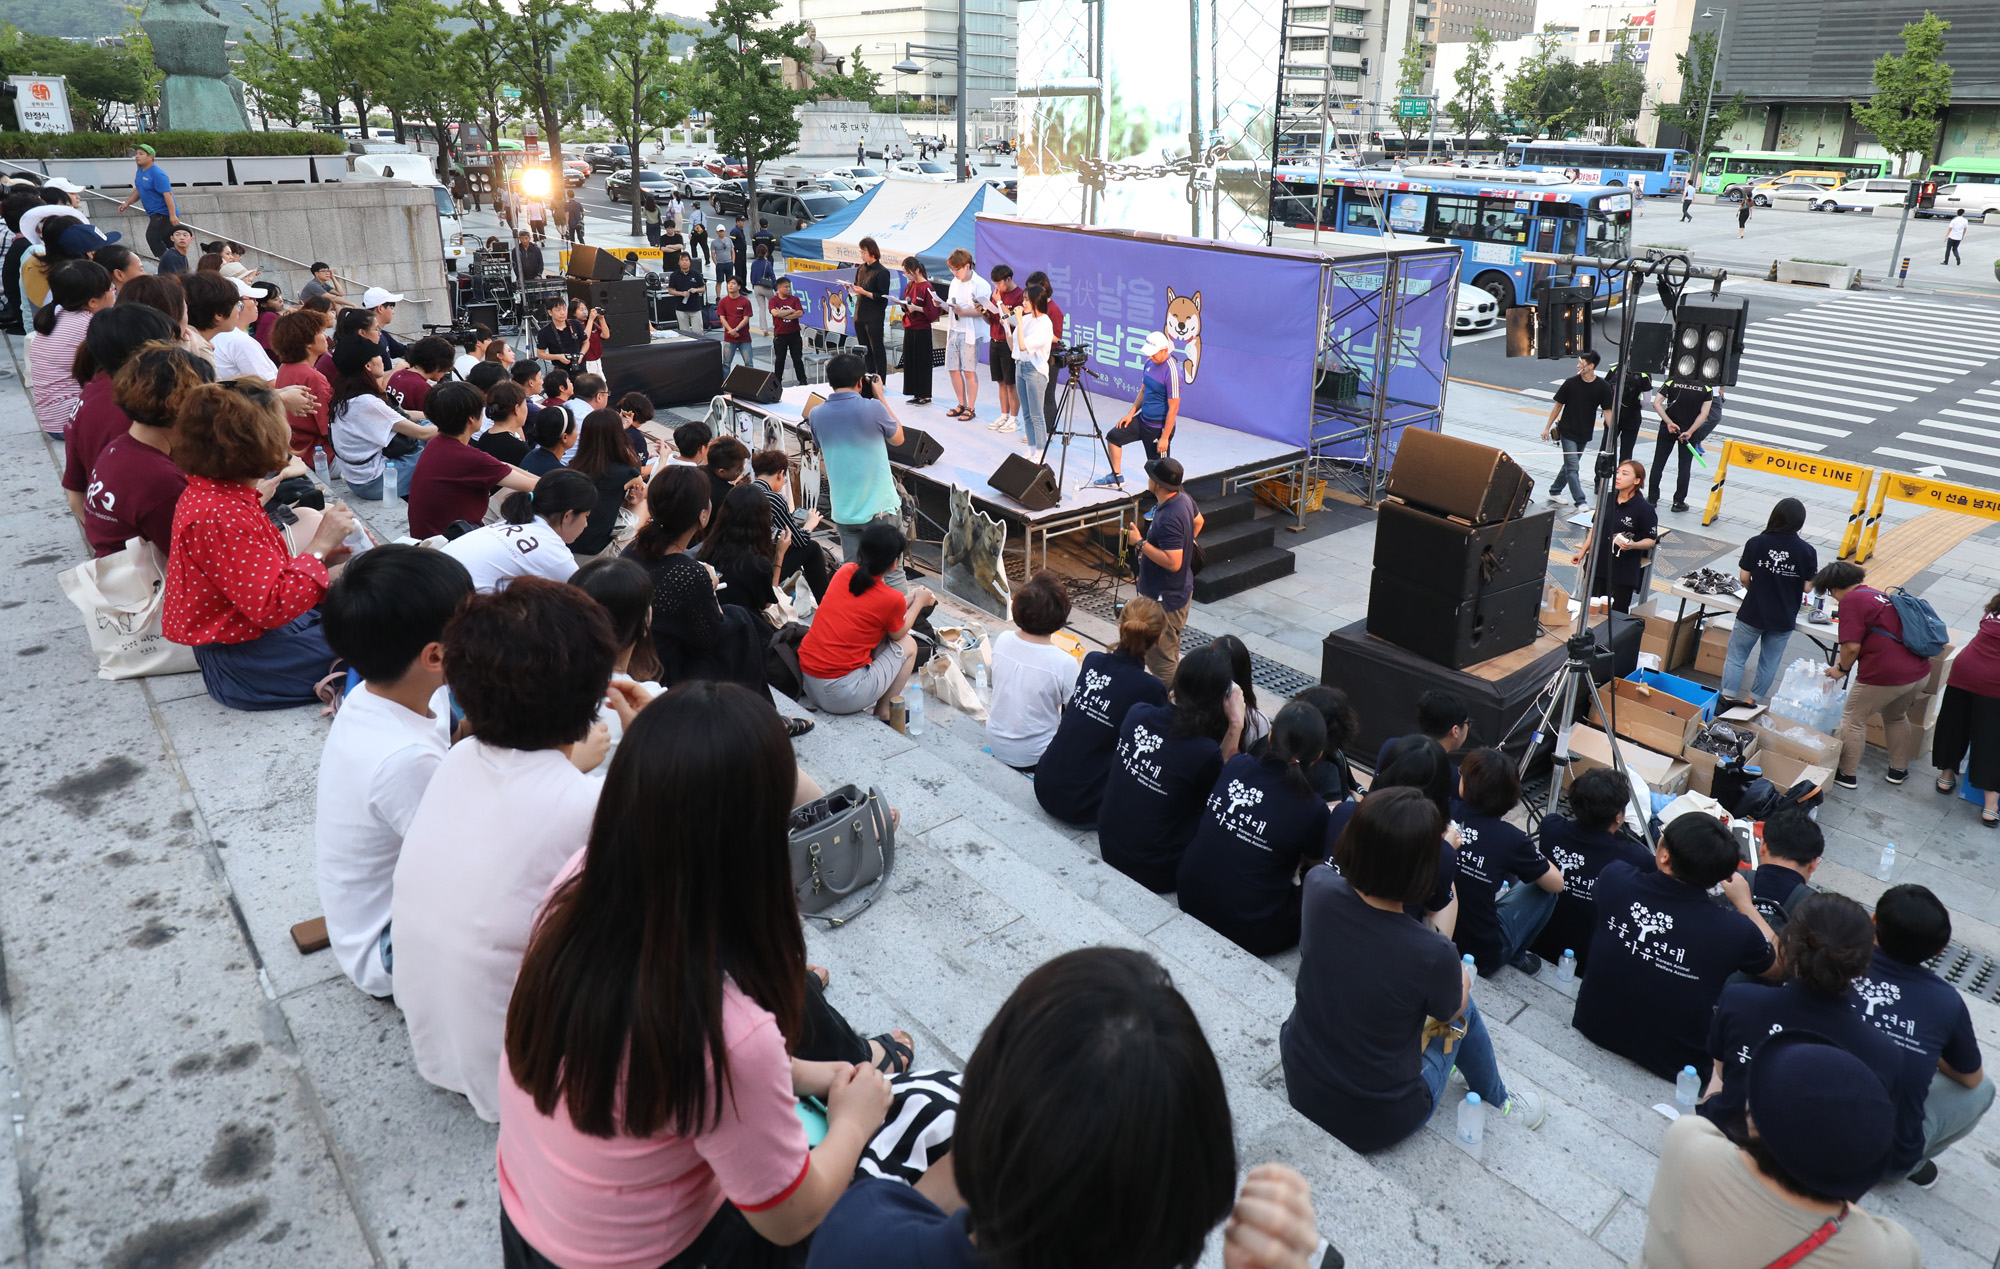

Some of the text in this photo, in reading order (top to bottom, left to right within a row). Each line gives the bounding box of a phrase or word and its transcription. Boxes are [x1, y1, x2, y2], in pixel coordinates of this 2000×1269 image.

[24, 111, 50, 120] 한정식
[829, 122, 869, 133] 세종대왕
[1578, 173, 1599, 182] 야놀자
[1673, 383, 1703, 392] POLICE
[1766, 456, 1853, 483] POLICE LINE
[1930, 489, 1942, 501] 이
[1945, 493, 1969, 506] 선을
[1074, 696, 1111, 712] 자유연대
[1123, 758, 1162, 779] 자유연대
[1216, 812, 1267, 835] 자유연대
[1236, 833, 1273, 852] Welfare Association
[1238, 827, 1267, 844] Korean Animal
[1456, 850, 1485, 869] 연대
[1460, 868, 1493, 884] Welfare Association
[1461, 863, 1487, 877] Korean Animal
[1564, 875, 1595, 891] 유연대
[1607, 916, 1630, 938] 동물
[1624, 940, 1686, 964] 자유연대
[1655, 957, 1691, 973] Korean Animal
[1655, 962, 1700, 980] Welfare Association
[1904, 1036, 1920, 1046] Animal
